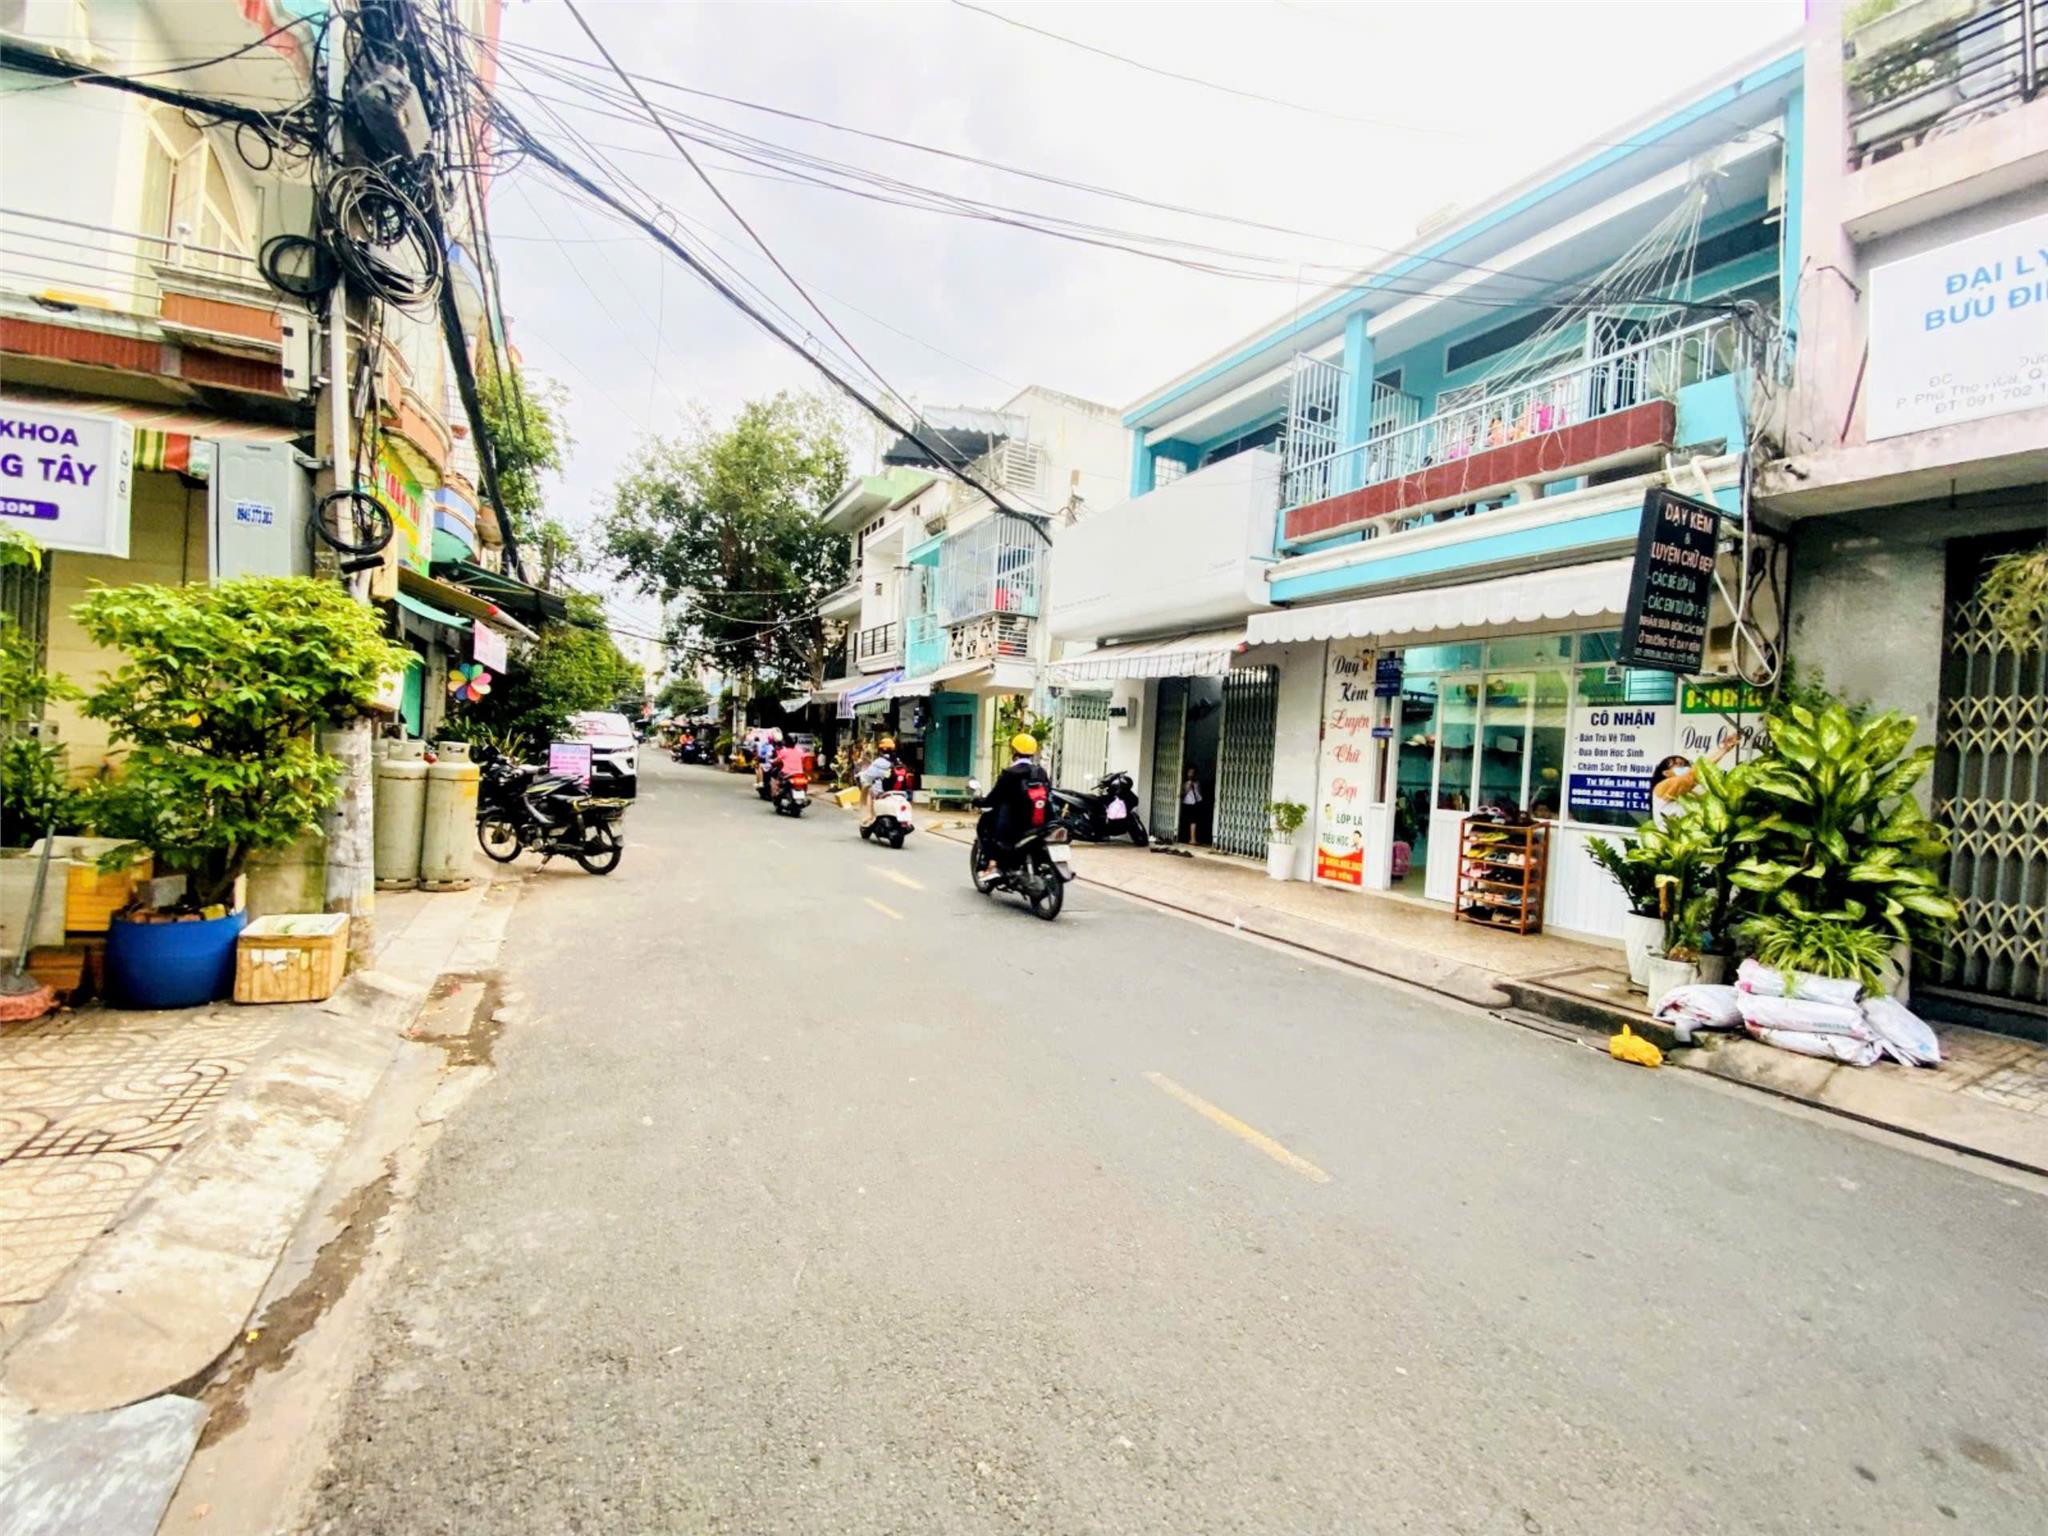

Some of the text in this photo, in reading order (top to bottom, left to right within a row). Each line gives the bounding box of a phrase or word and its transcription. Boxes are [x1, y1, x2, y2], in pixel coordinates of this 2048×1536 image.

[1946, 262, 2002, 295] ĐẠI
[1925, 295, 1995, 331] BƯU
[0, 418, 79, 447] KHOA
[38, 453, 97, 487] TÂY
[1665, 503, 1688, 527] DẠY
[1651, 541, 1680, 566] LUYỆN
[1333, 655, 1360, 678] Dạy
[1338, 682, 1368, 702] Kèm
[1590, 708, 1655, 729] CÔ NHẬN
[1626, 748, 1644, 758] Sinh
[1616, 779, 1637, 788] Liên
